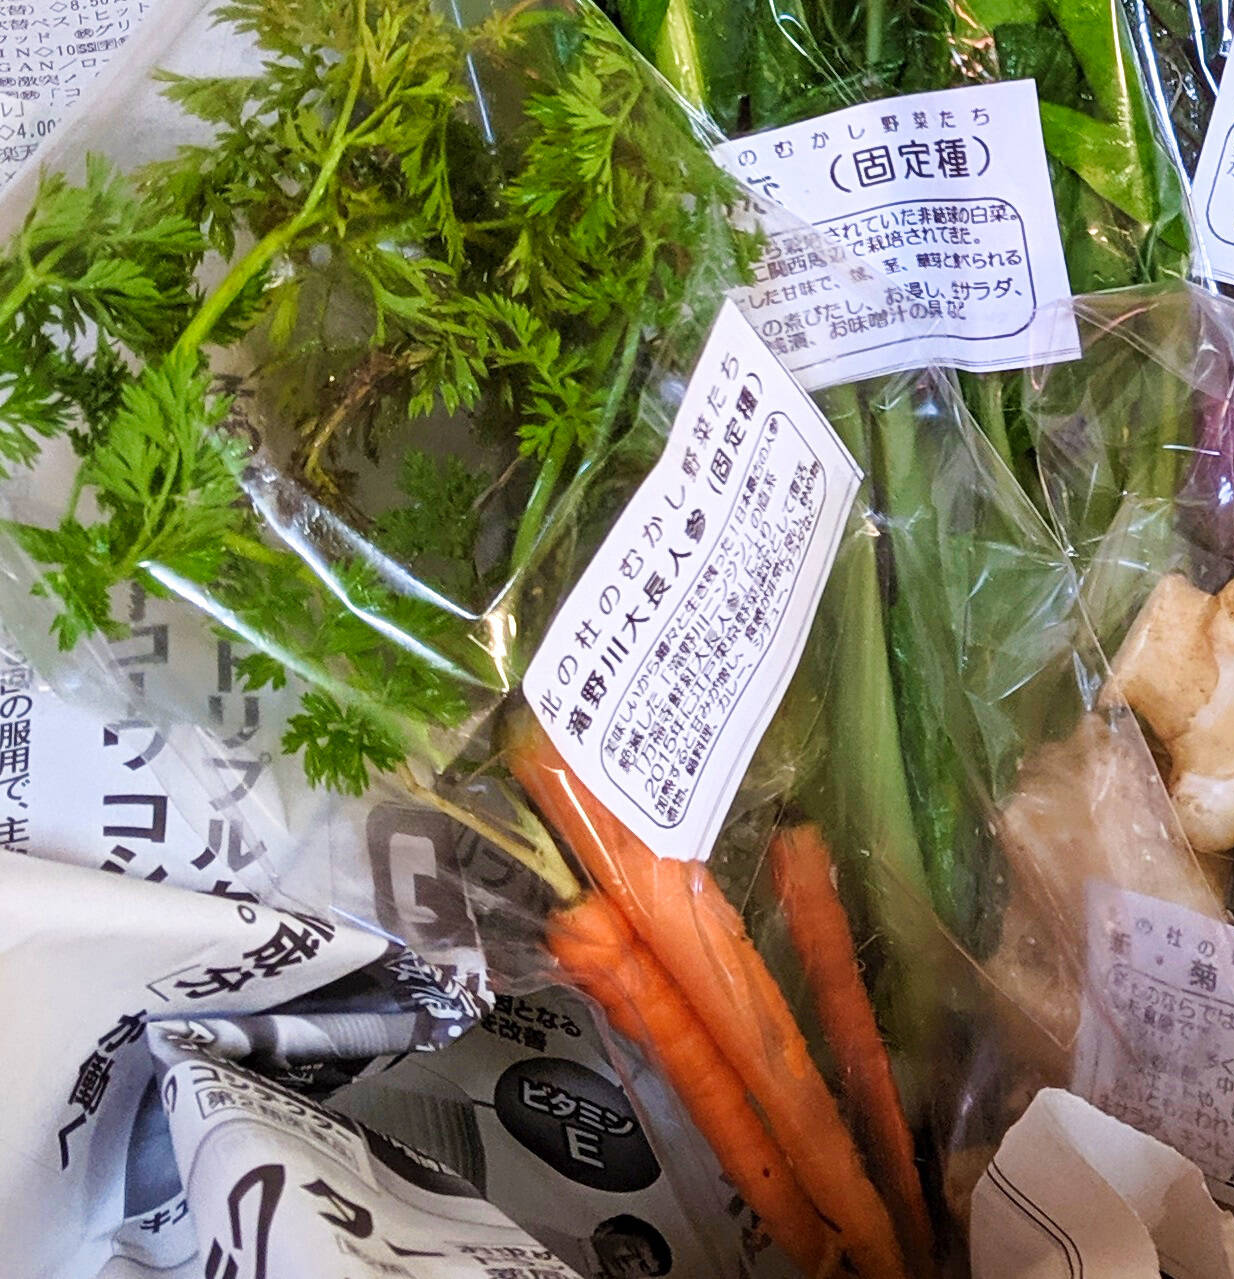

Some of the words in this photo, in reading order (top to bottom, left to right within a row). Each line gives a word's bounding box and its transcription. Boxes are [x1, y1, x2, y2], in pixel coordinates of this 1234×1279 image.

[829, 135, 991, 193] （固定種）
[537, 351, 745, 721] 北の杜のむかし野菜たち
[521, 1079, 635, 1135] ビタミン
